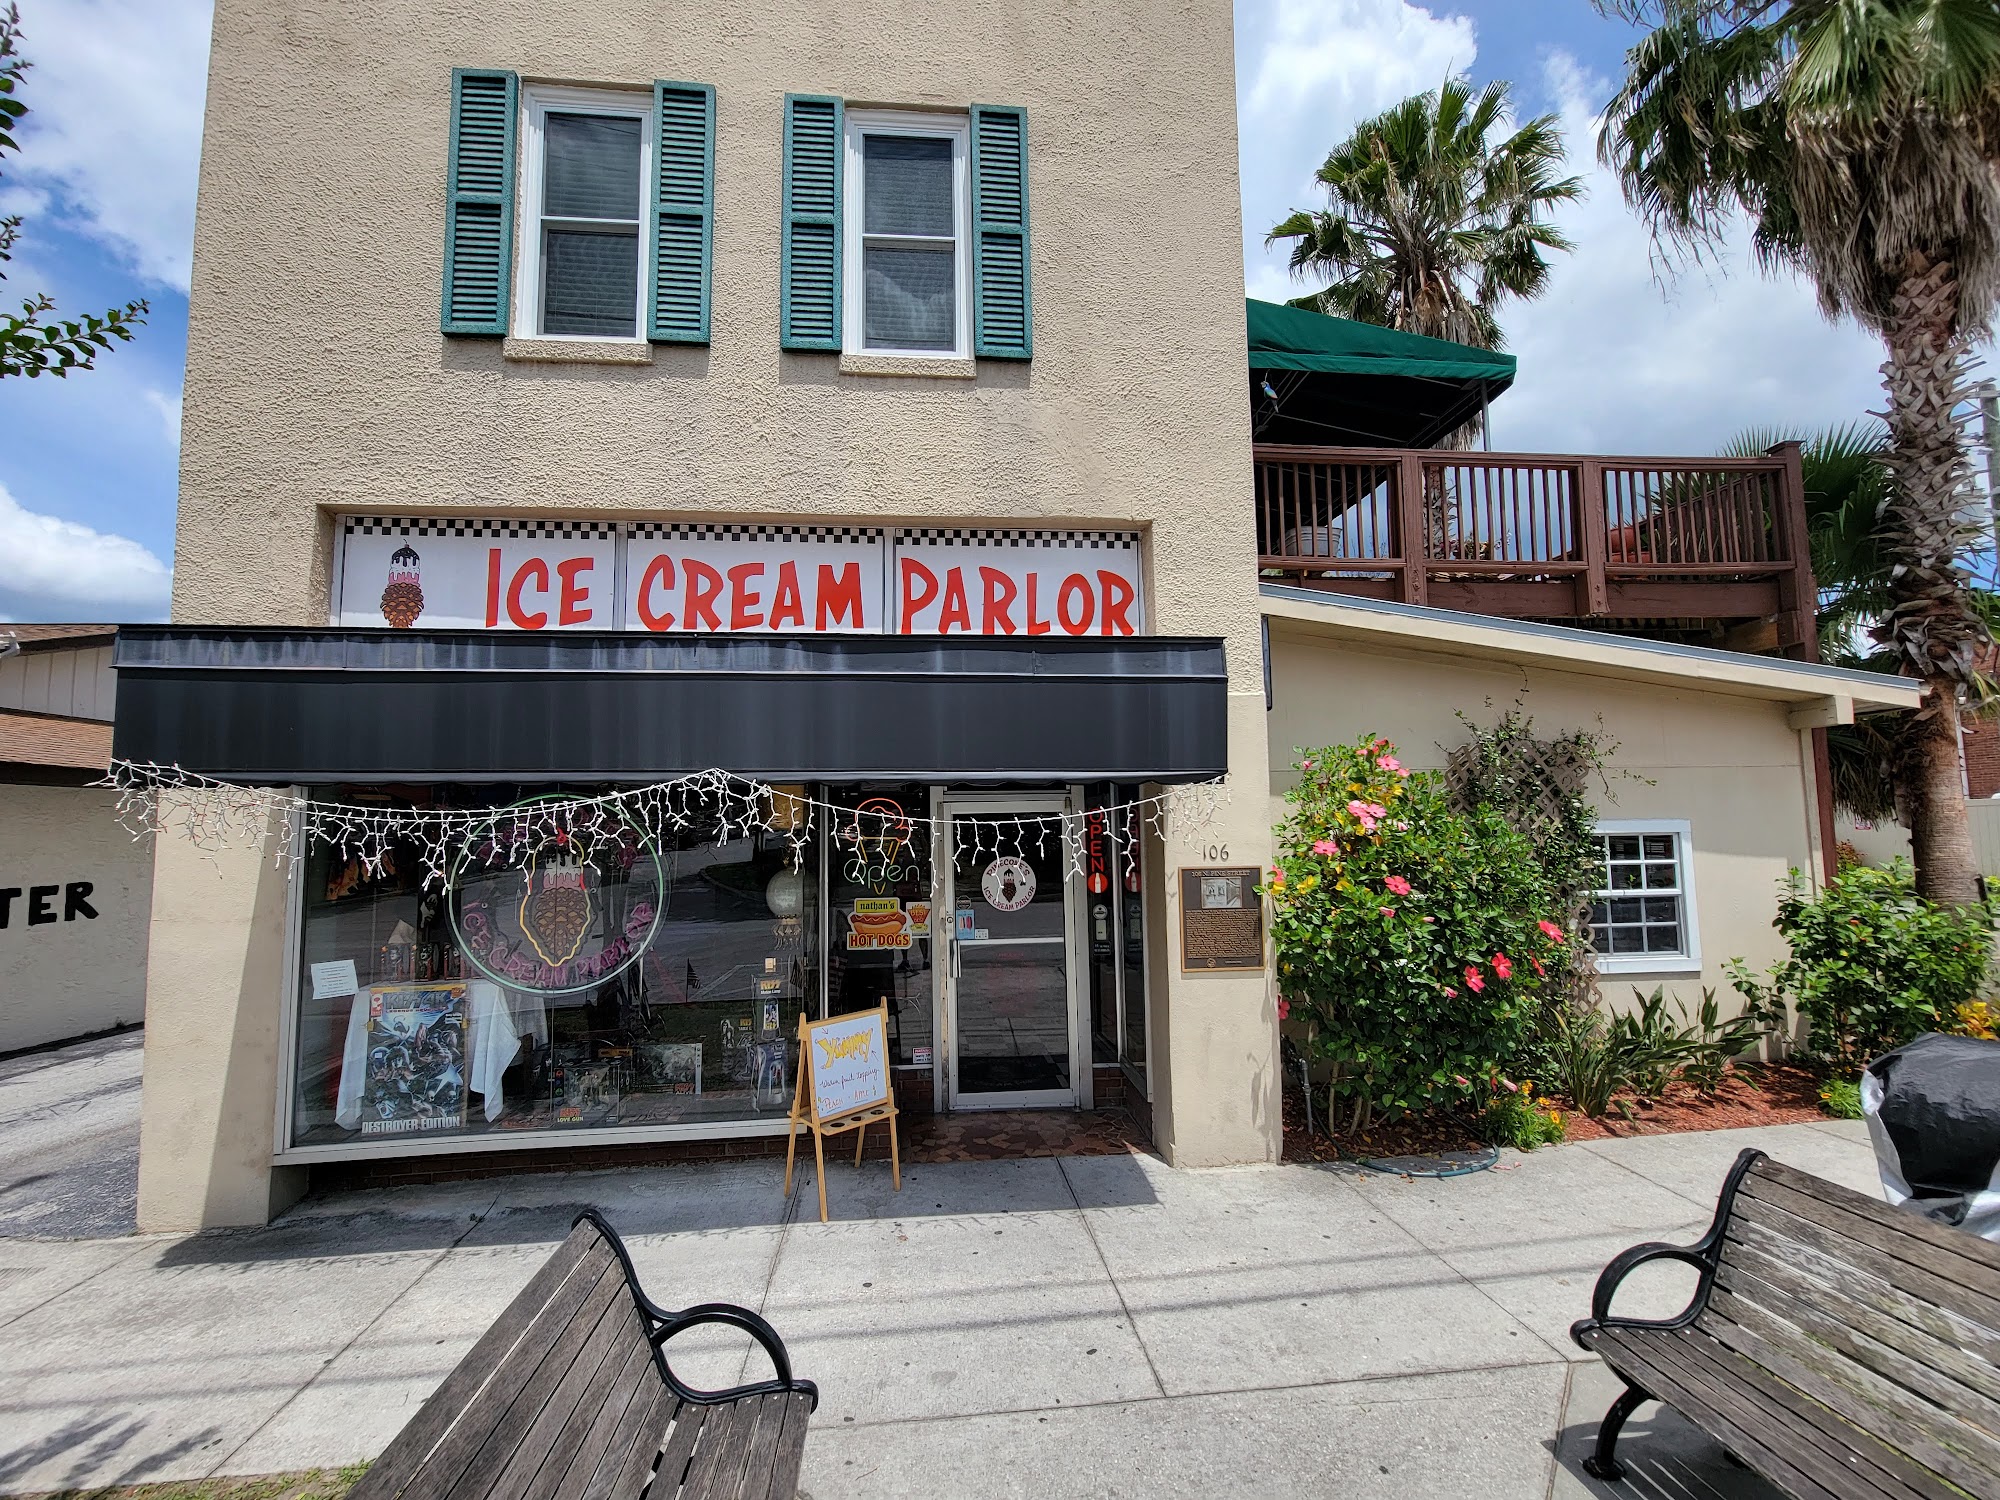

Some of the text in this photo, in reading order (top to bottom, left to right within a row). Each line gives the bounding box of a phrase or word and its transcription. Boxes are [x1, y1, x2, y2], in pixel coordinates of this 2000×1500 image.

[485, 548, 1136, 637] ICE CREAM PARLOR
[1088, 808, 1105, 873] OPEN
[1202, 843, 1230, 861] 106
[843, 858, 920, 889] Open
[860, 901, 895, 910] nathan's
[992, 899, 1014, 911] CREAM
[1015, 886, 1036, 909] PARLOR
[850, 933, 875, 947] HOT
[877, 934, 911, 947] DOGS
[362, 1116, 461, 1134] DESTROYER EDITION
